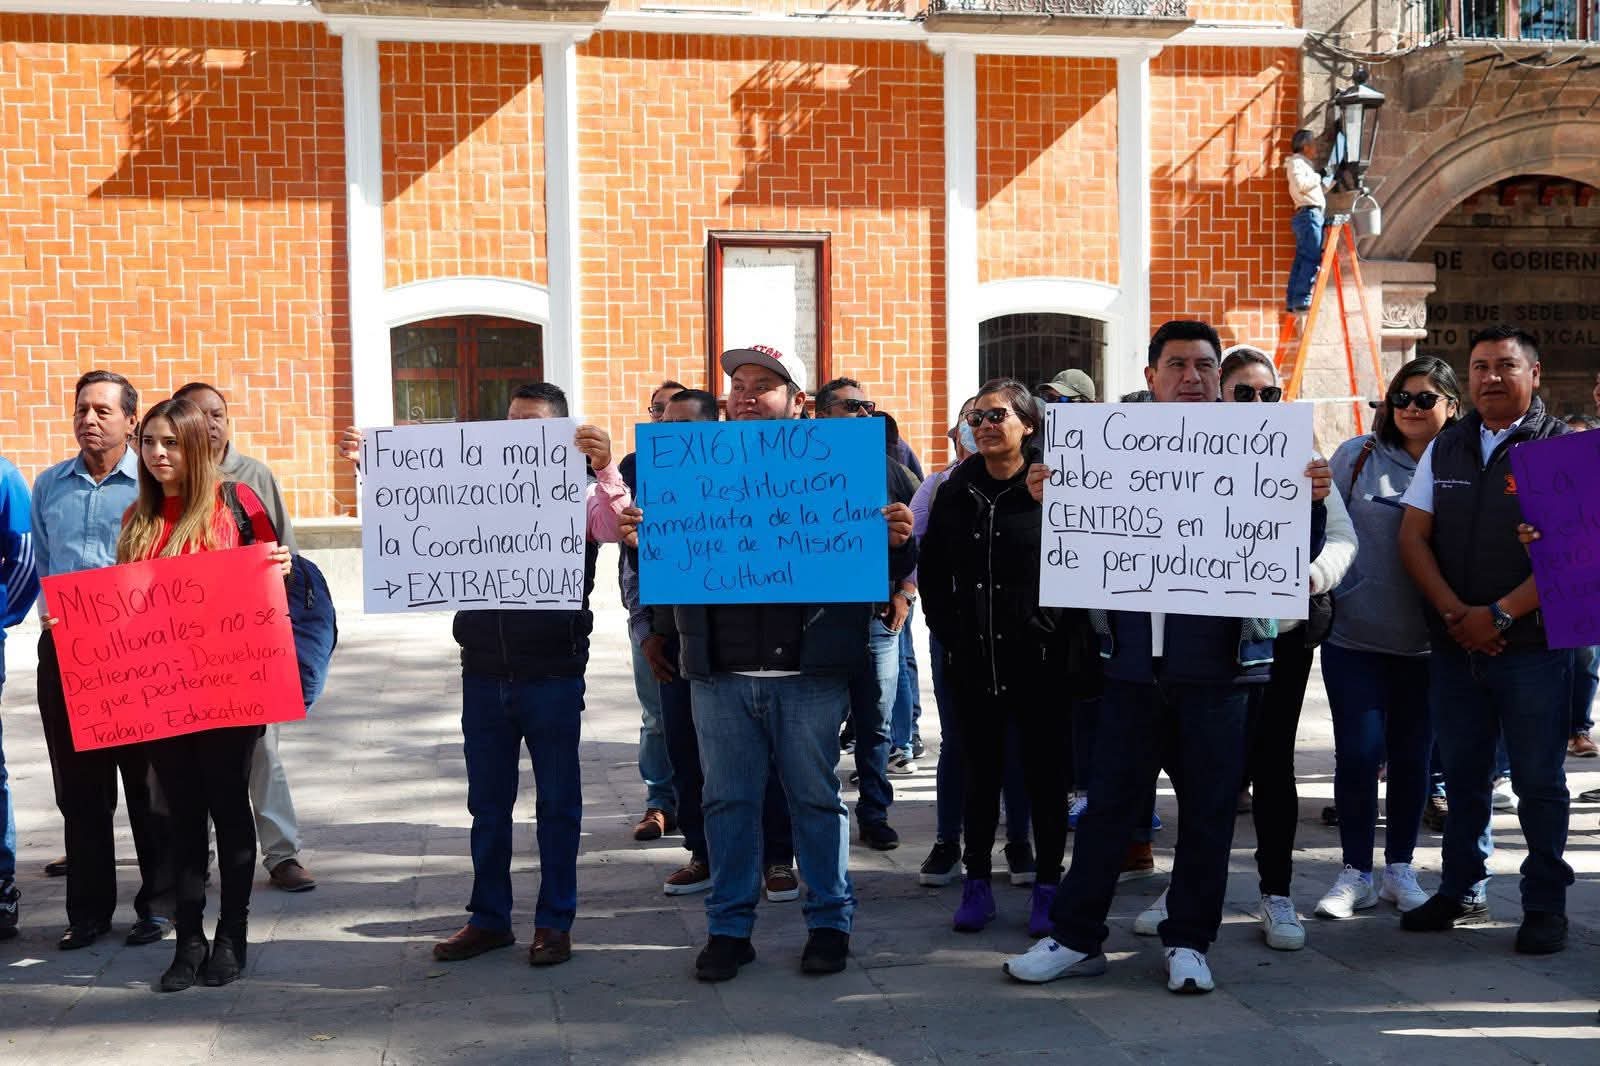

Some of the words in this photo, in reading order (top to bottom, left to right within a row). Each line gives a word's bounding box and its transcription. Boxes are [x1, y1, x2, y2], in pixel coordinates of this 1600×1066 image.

[1434, 250, 1463, 271] DE
[1491, 250, 1600, 271] GOBIERN
[1464, 304, 1500, 320] FUE
[1516, 304, 1565, 320] SEDE
[362, 429, 444, 475] ¡Fuera
[460, 428, 482, 467] la
[503, 425, 568, 468] mala
[1045, 409, 1084, 453] ¡La
[1103, 411, 1288, 458] Coordinación
[642, 479, 677, 507] La
[1048, 454, 1113, 490] debe
[1129, 469, 1205, 493] servir
[1214, 475, 1234, 497] a
[1254, 462, 1298, 500] los
[375, 469, 542, 522] organización!
[551, 470, 581, 504] de
[769, 509, 793, 526] de
[800, 504, 821, 524] la
[1048, 501, 1163, 534] CENTROS
[1177, 517, 1204, 537] en
[1226, 506, 1291, 558] lugar
[378, 524, 400, 557] la
[412, 521, 552, 559] Coordinación
[560, 517, 583, 555] de
[642, 544, 664, 561] de
[737, 536, 759, 552] de
[778, 530, 863, 555] Misión
[1047, 536, 1080, 569] de
[408, 567, 584, 602] EXTRAESCOLAR
[703, 561, 794, 592] Cultural
[219, 613, 245, 634] no
[253, 608, 277, 625] se
[100, 693, 137, 720] que
[248, 664, 267, 682] al
[82, 722, 155, 744] Trabajo
[161, 702, 264, 728] Educativo
